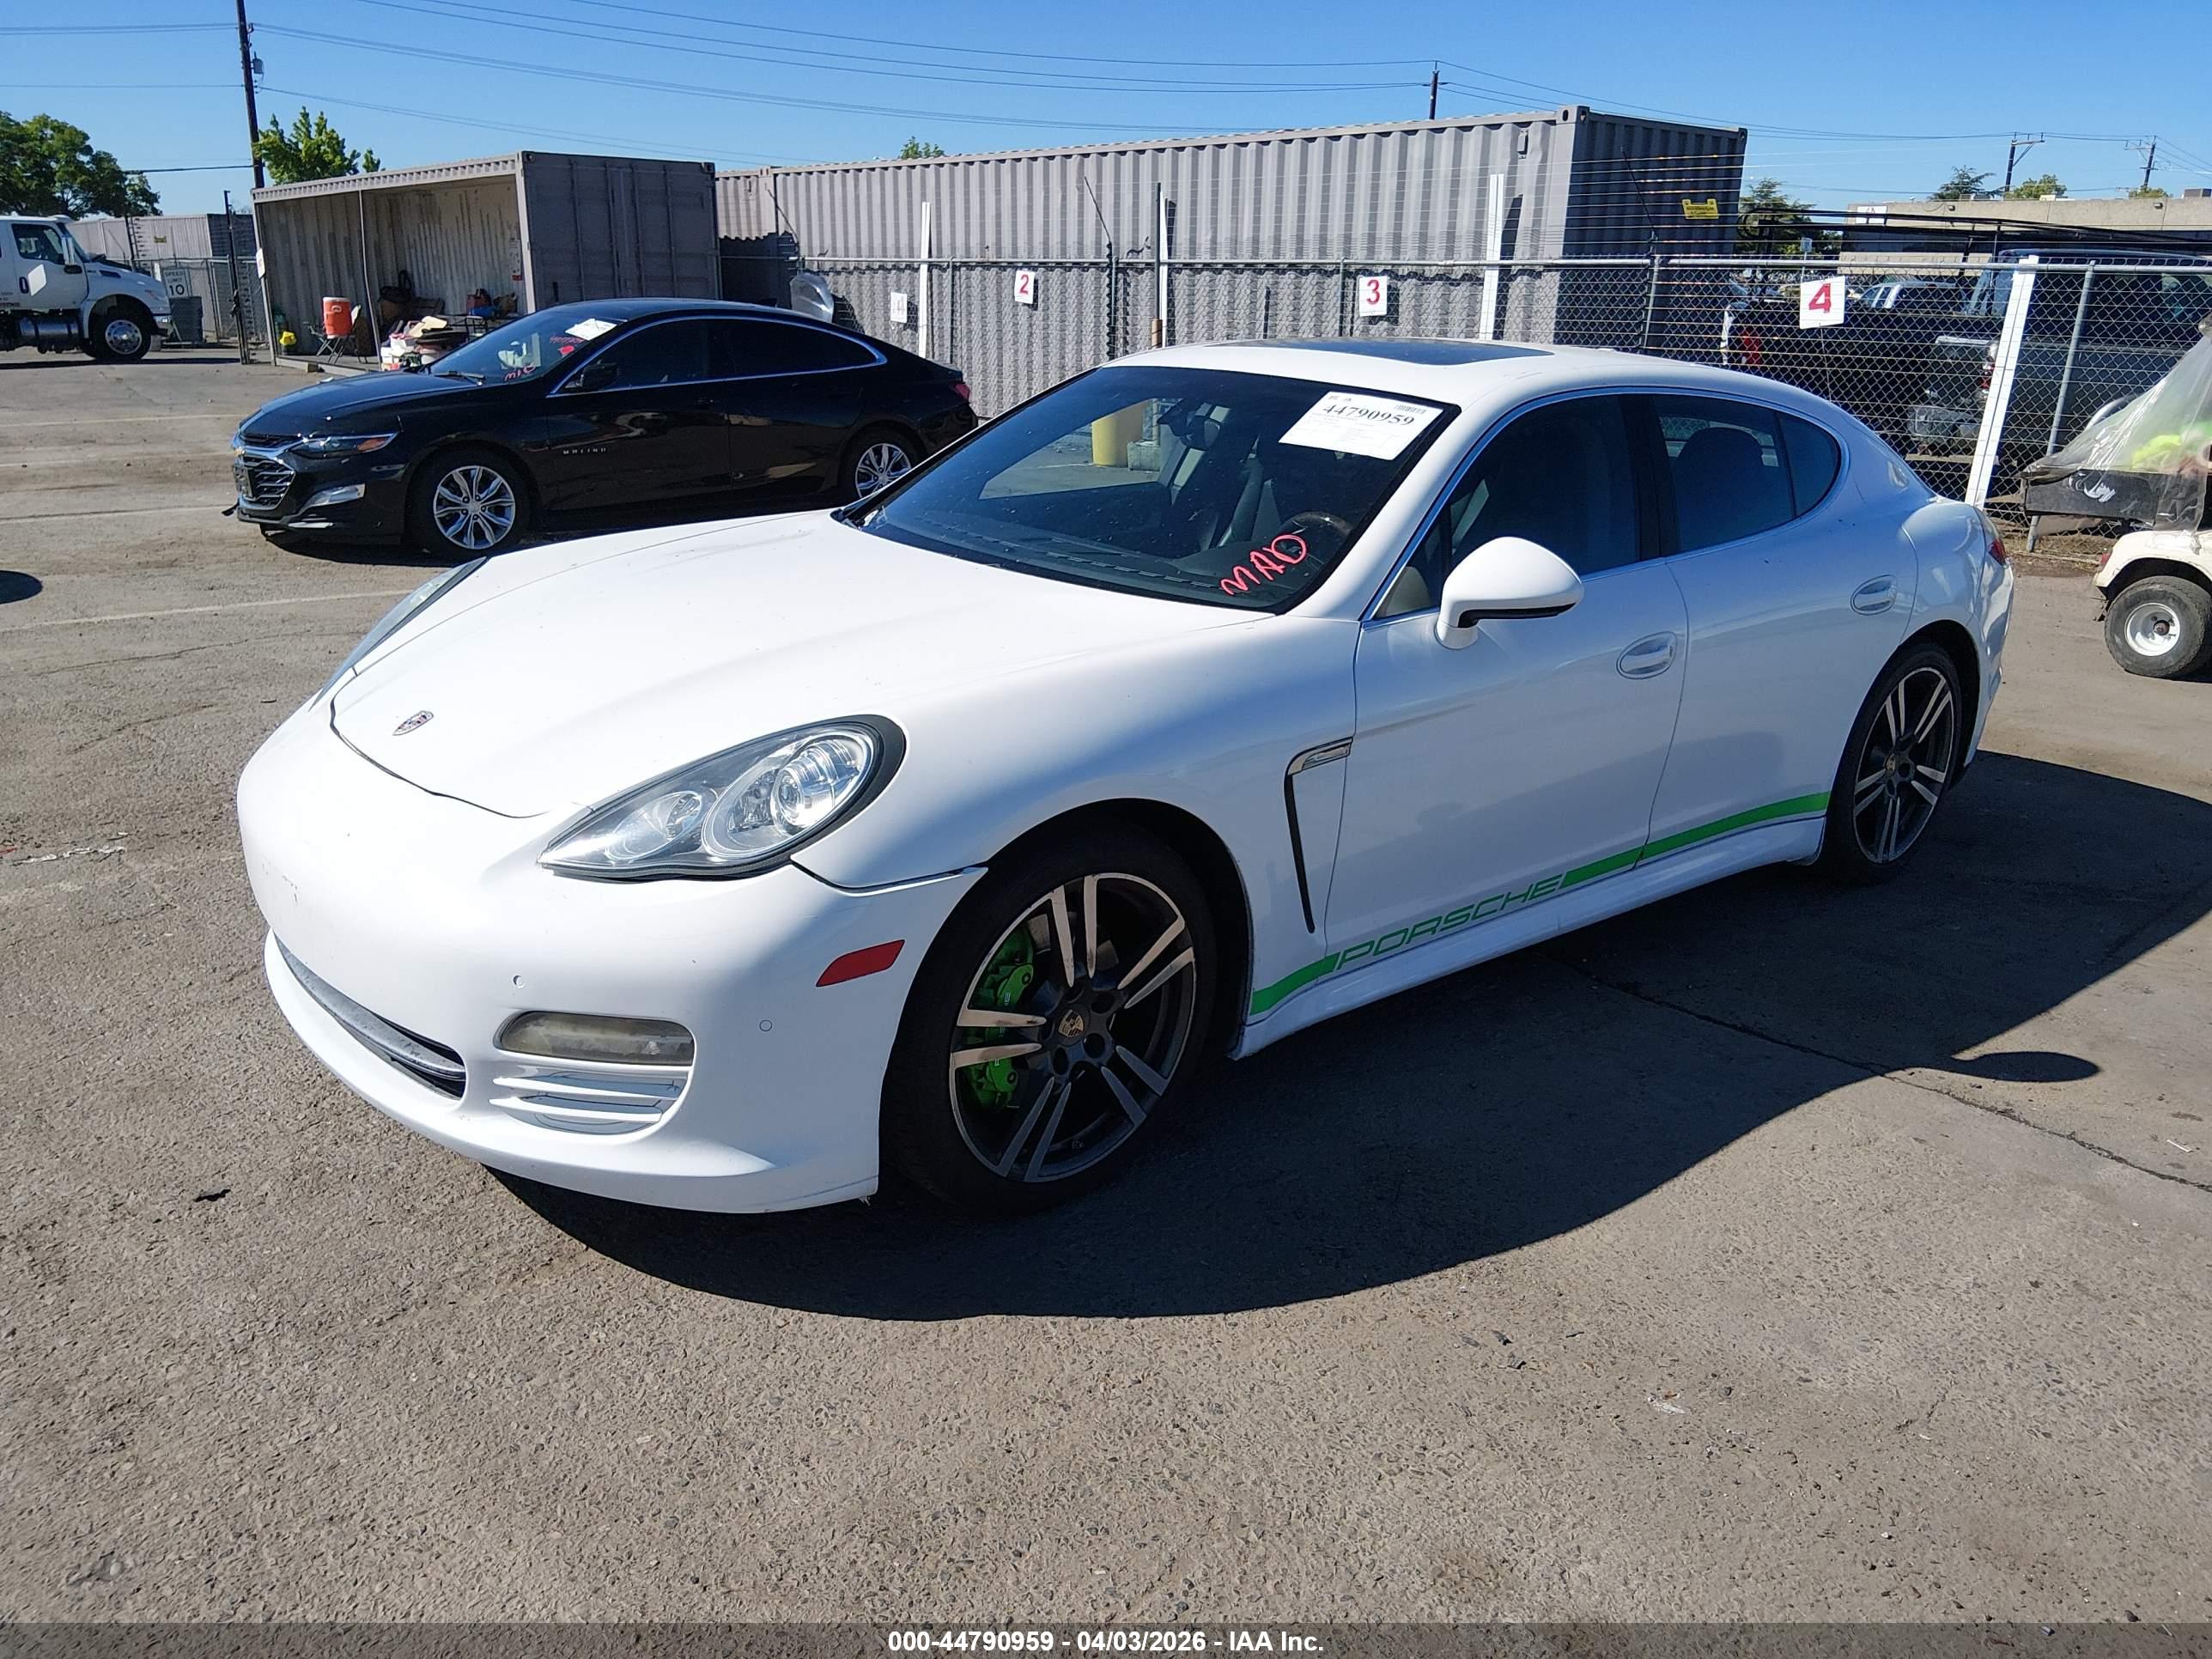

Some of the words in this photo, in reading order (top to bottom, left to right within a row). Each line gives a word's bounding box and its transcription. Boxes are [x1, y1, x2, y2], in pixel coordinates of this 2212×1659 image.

[169, 284, 185, 296] 10
[1019, 274, 1029, 295] 2
[1366, 279, 1380, 305] 3
[1808, 283, 1831, 313] 4
[1323, 404, 1415, 426] 44790959
[1336, 874, 1563, 970] PORSCHE
